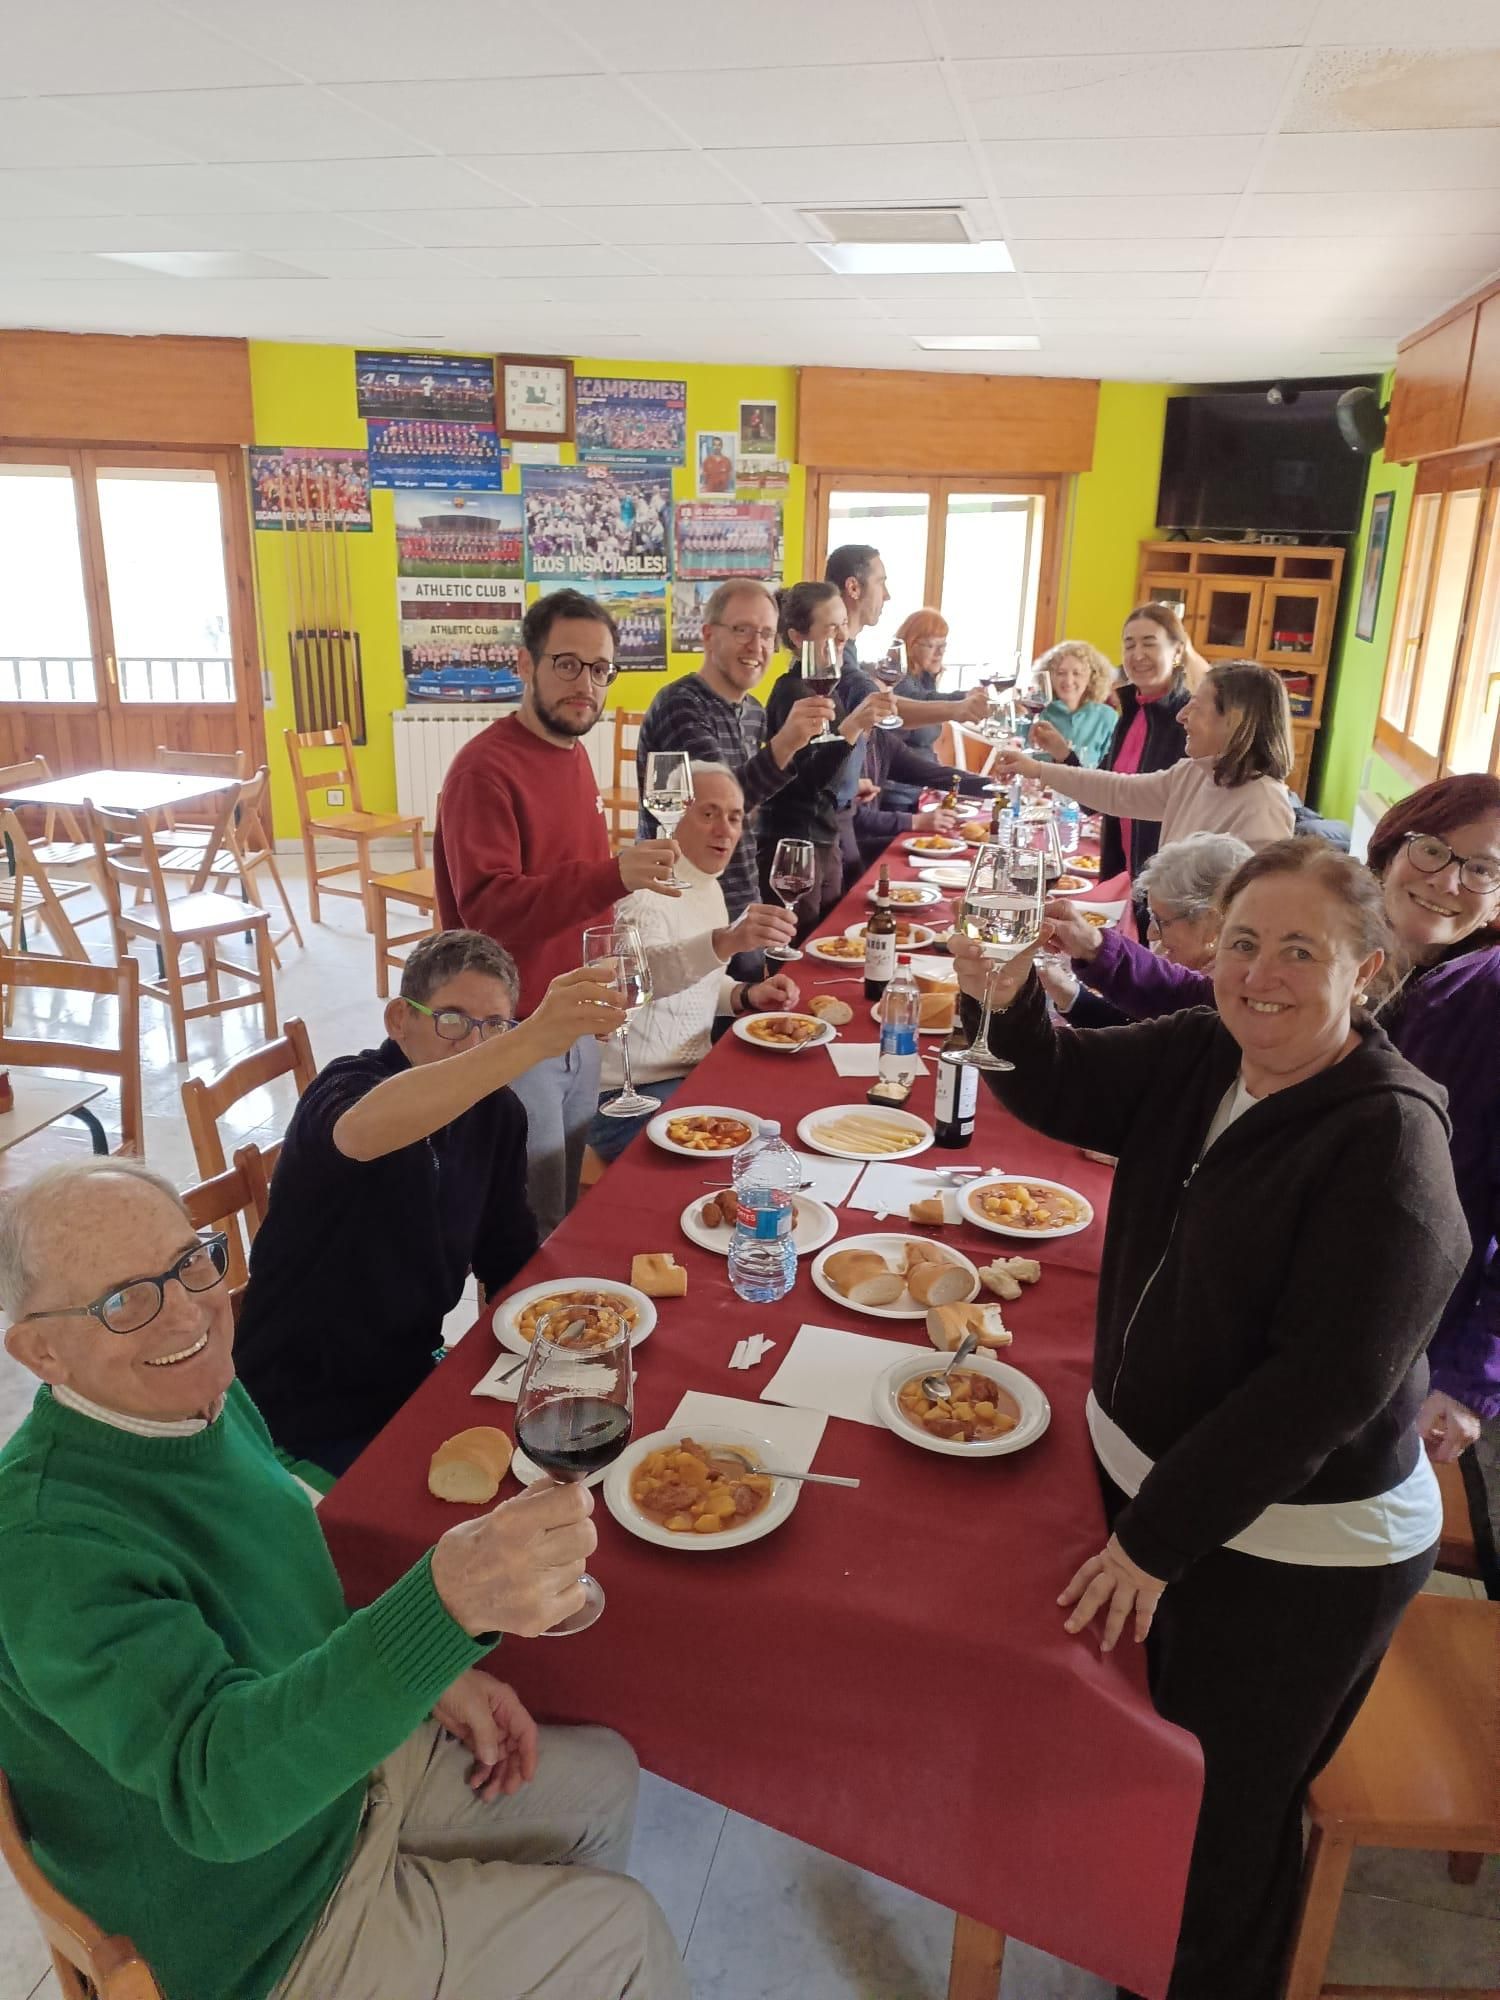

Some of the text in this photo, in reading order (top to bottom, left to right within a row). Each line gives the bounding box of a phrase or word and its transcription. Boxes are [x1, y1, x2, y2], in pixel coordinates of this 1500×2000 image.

[576, 379, 685, 400] ¡CAMPEONES!
[569, 556, 667, 573] INSACIABLES!
[416, 584, 506, 597] ATHLETIC CLUB
[430, 624, 499, 635] ATHLETIC CLUB
